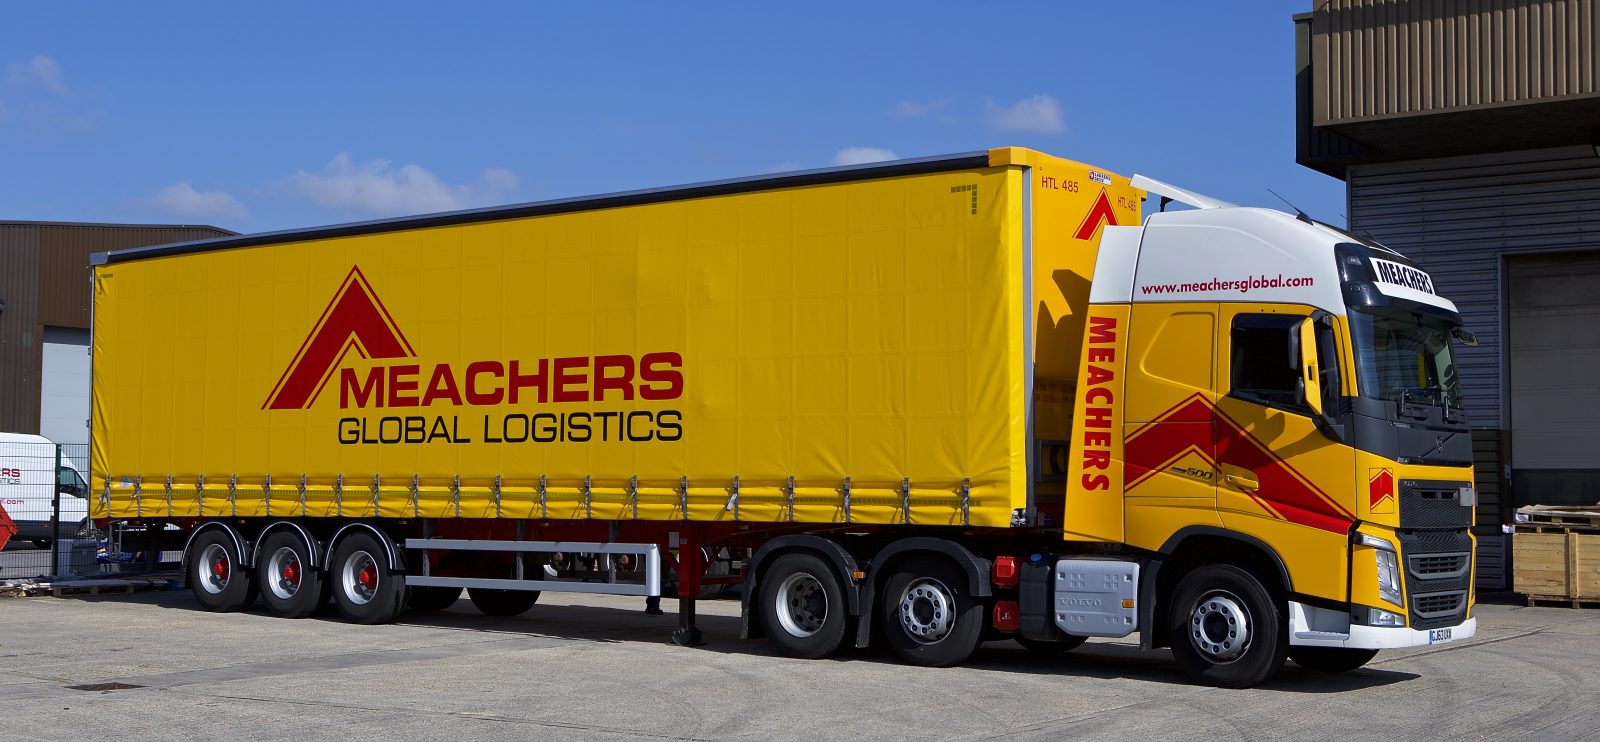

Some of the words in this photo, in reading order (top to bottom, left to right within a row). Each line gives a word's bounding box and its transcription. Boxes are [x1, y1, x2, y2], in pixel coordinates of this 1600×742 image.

[1041, 176, 1058, 190] HTL
[1062, 180, 1079, 193] 485
[1118, 196, 1127, 209] HTL
[1142, 274, 1314, 294] www.meachersglobal.com
[1376, 261, 1434, 295] MEACHERS
[339, 351, 684, 409] MEACHERS
[1081, 316, 1118, 491] MEACHERS
[338, 415, 471, 445] GLOBAL
[483, 410, 683, 444] LOGISTICS
[0, 468, 20, 478] RS
[1188, 467, 1213, 479] 500
[1059, 598, 1103, 607] VOLVO
